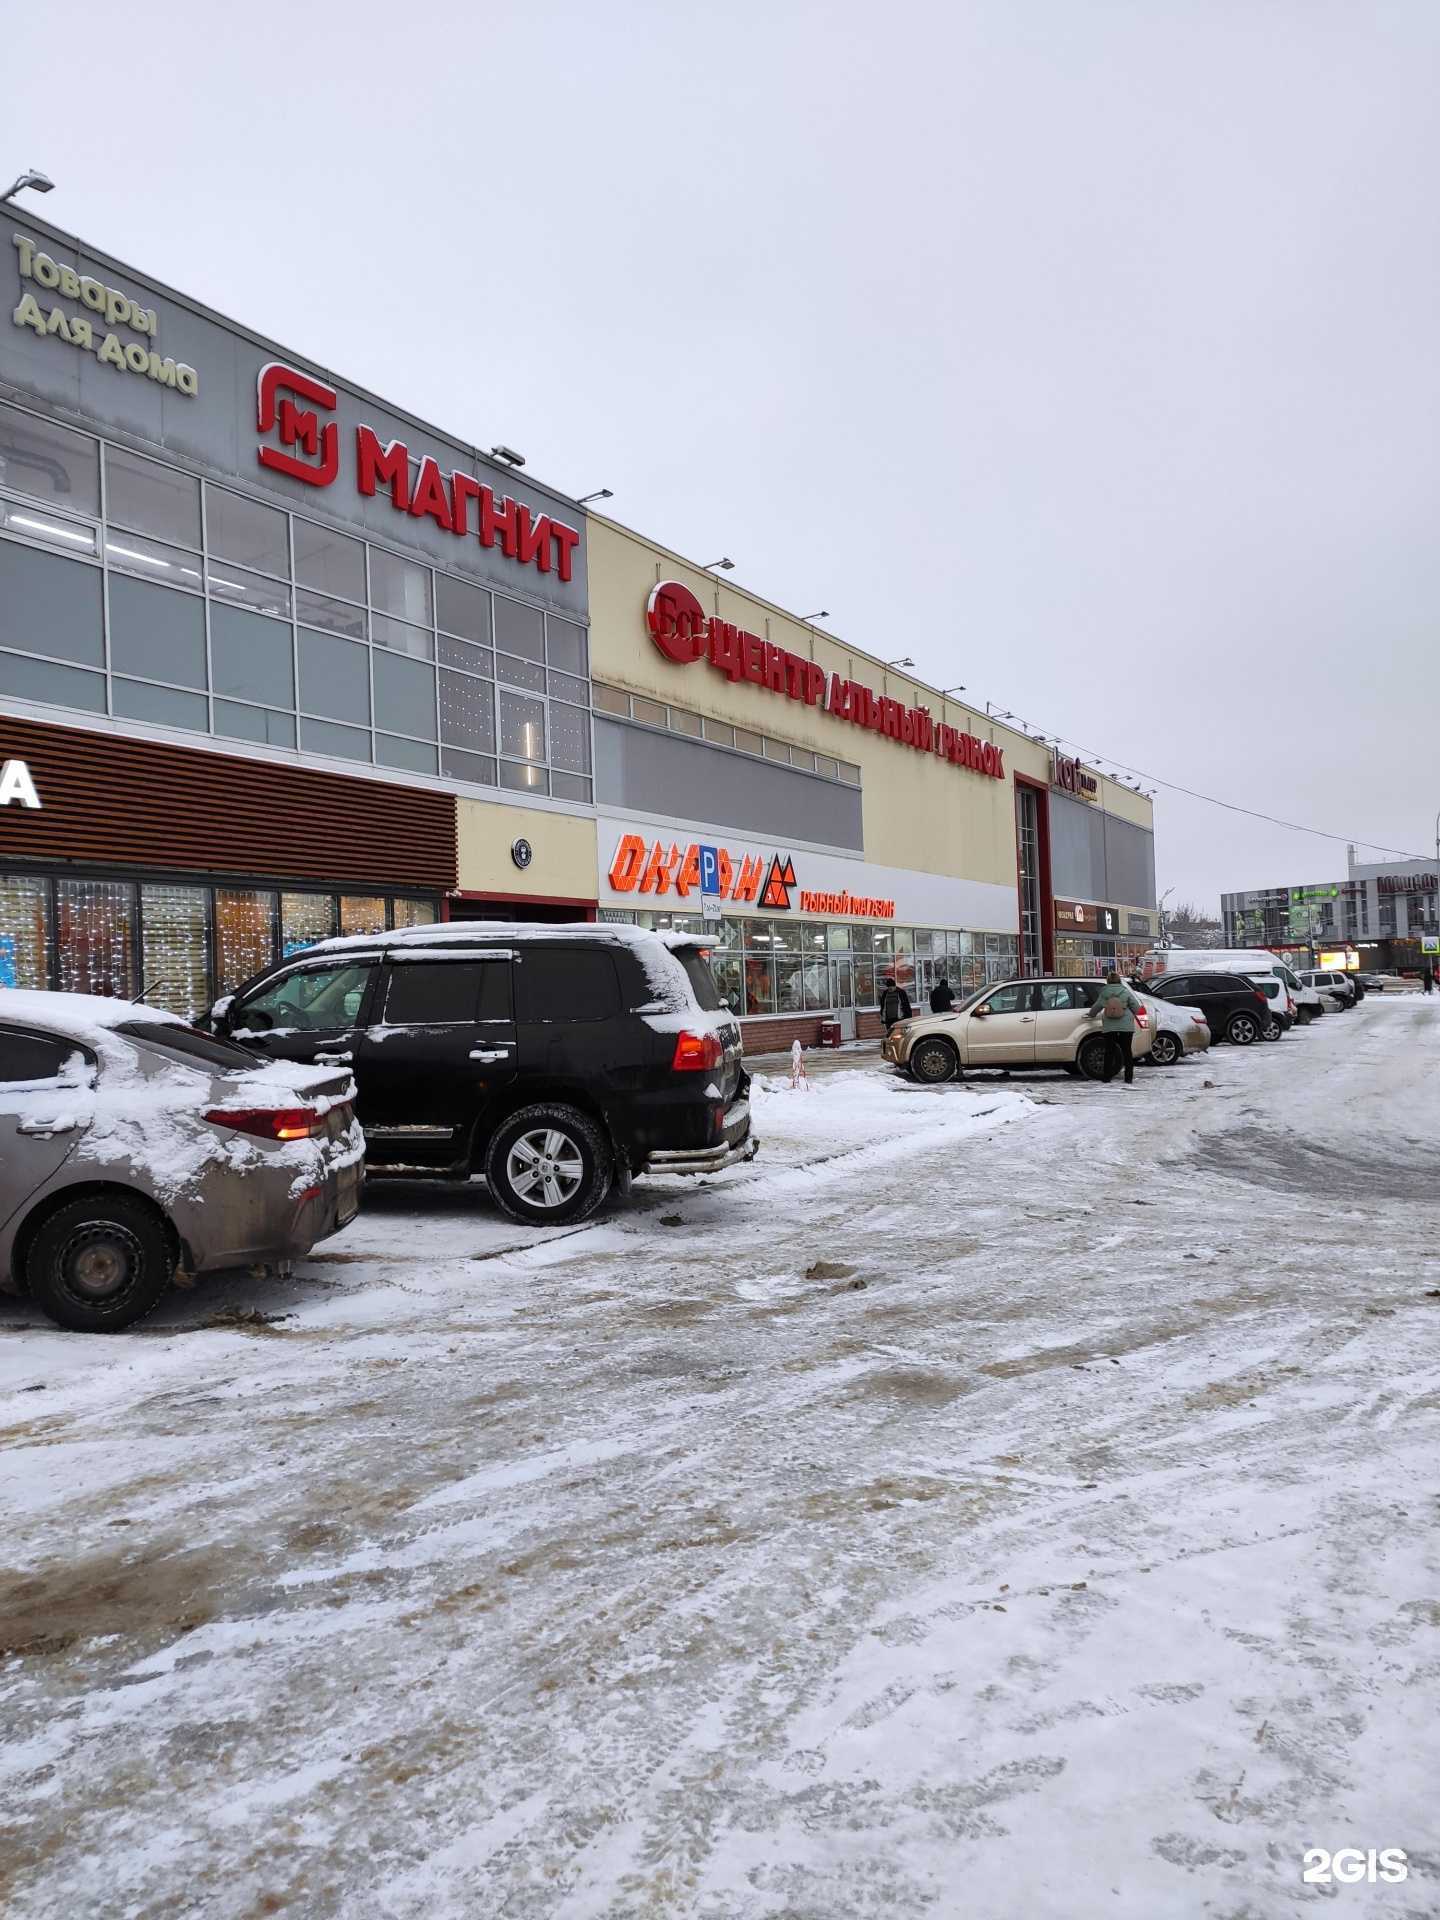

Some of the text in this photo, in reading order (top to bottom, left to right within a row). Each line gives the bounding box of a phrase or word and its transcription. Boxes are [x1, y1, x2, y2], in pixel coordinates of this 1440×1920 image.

[13, 233, 158, 337] Товары
[97, 333, 199, 397] дома
[356, 423, 580, 582] МАГНИТ
[708, 615, 1006, 780] ЦЕНТРАЛЬНЫЙ РЫНОК
[800, 889, 896, 919] РЫБНЫЙ МАГАЗИН
